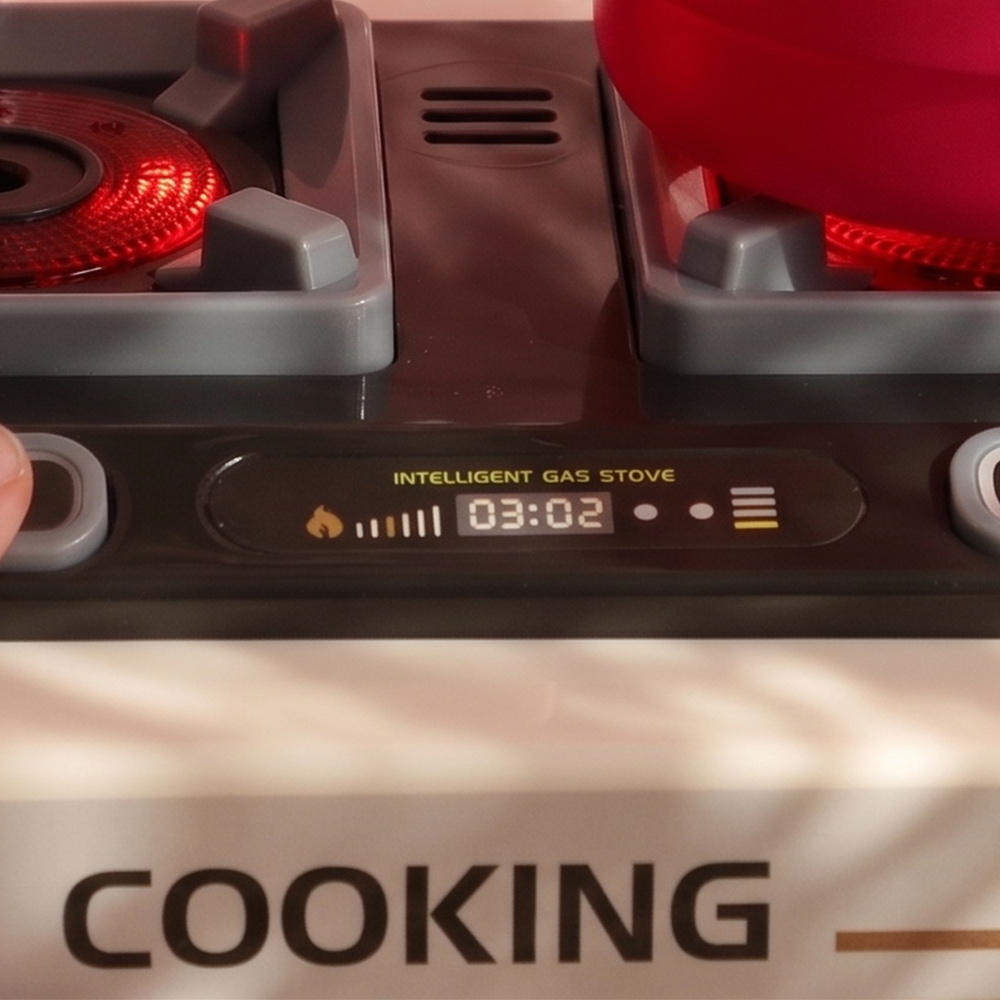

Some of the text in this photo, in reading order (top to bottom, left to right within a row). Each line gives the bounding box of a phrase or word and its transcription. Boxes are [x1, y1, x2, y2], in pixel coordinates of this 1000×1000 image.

[393, 469, 676, 485] INTELLIGENT GAS STOVE
[468, 497, 603, 530] 03:02
[63, 861, 770, 970] COOKING
